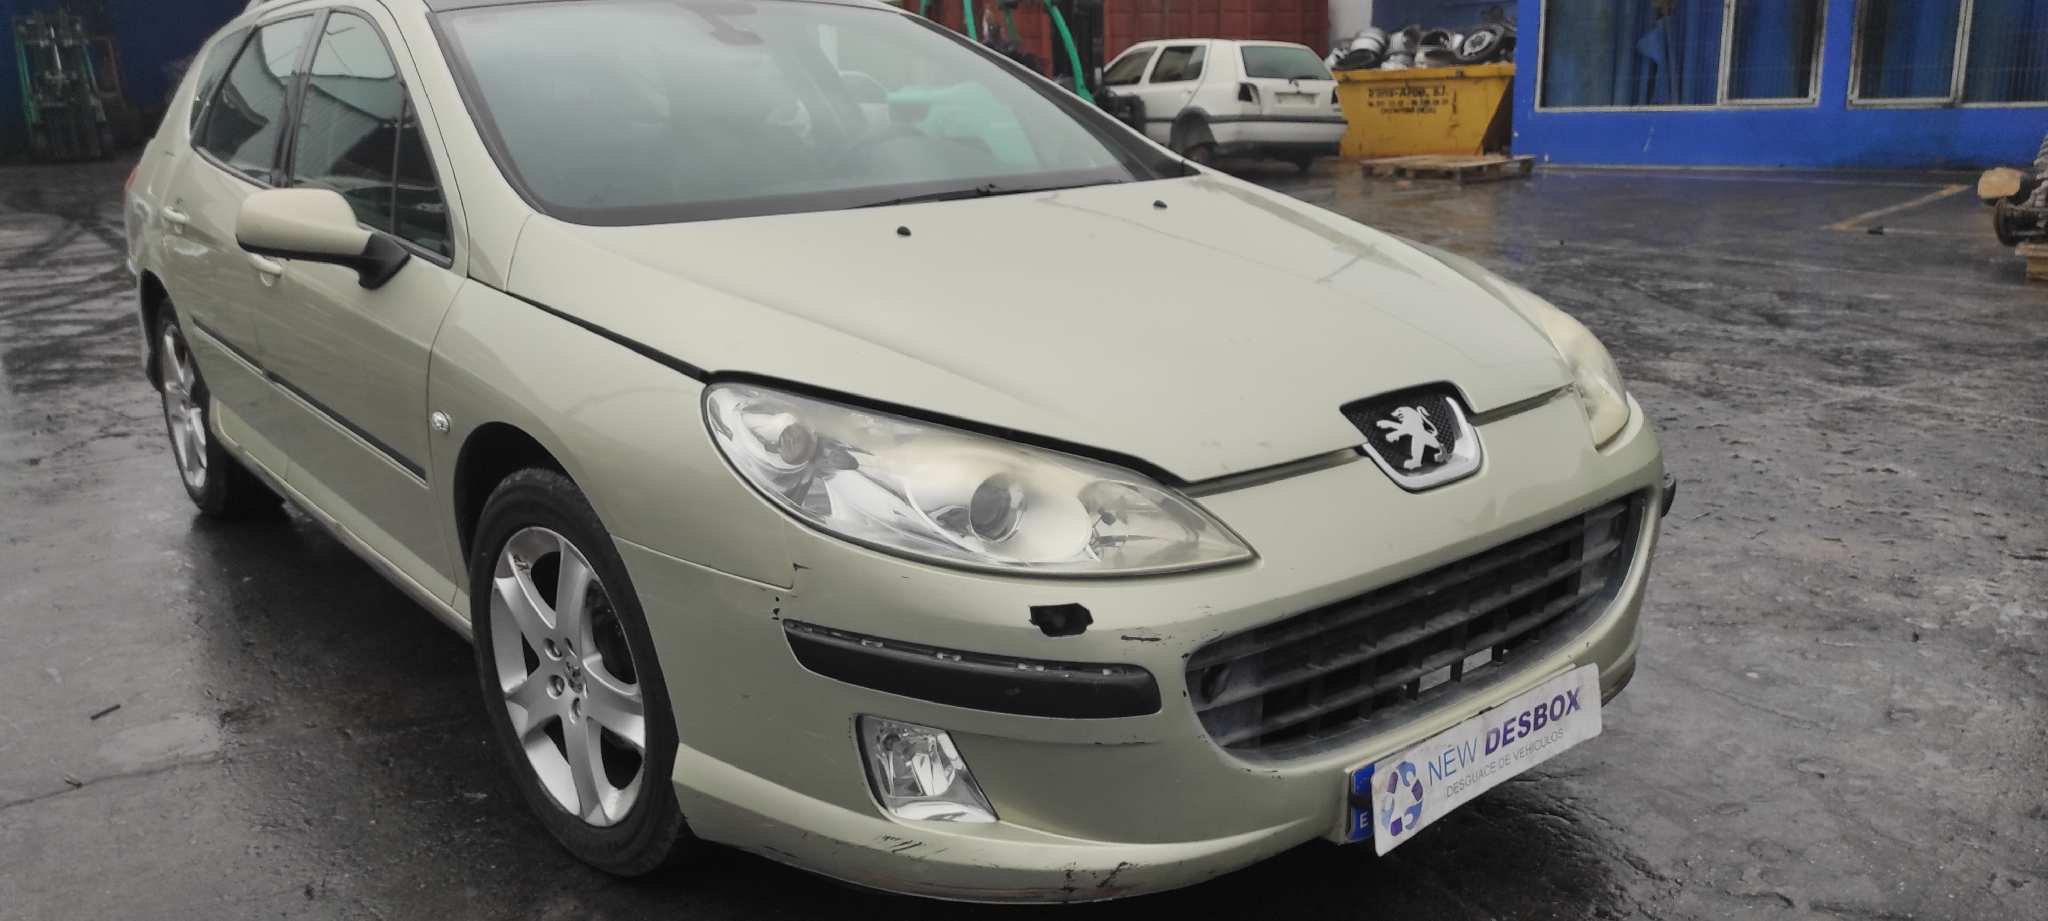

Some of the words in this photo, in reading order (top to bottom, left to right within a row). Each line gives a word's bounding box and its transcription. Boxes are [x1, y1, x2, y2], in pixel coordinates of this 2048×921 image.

[1427, 736, 1479, 786] NEW
[1484, 687, 1581, 756] DESBOX
[1446, 761, 1496, 798] DESGUACE
[1499, 756, 1512, 769] DE
[1360, 812, 1369, 829] E
